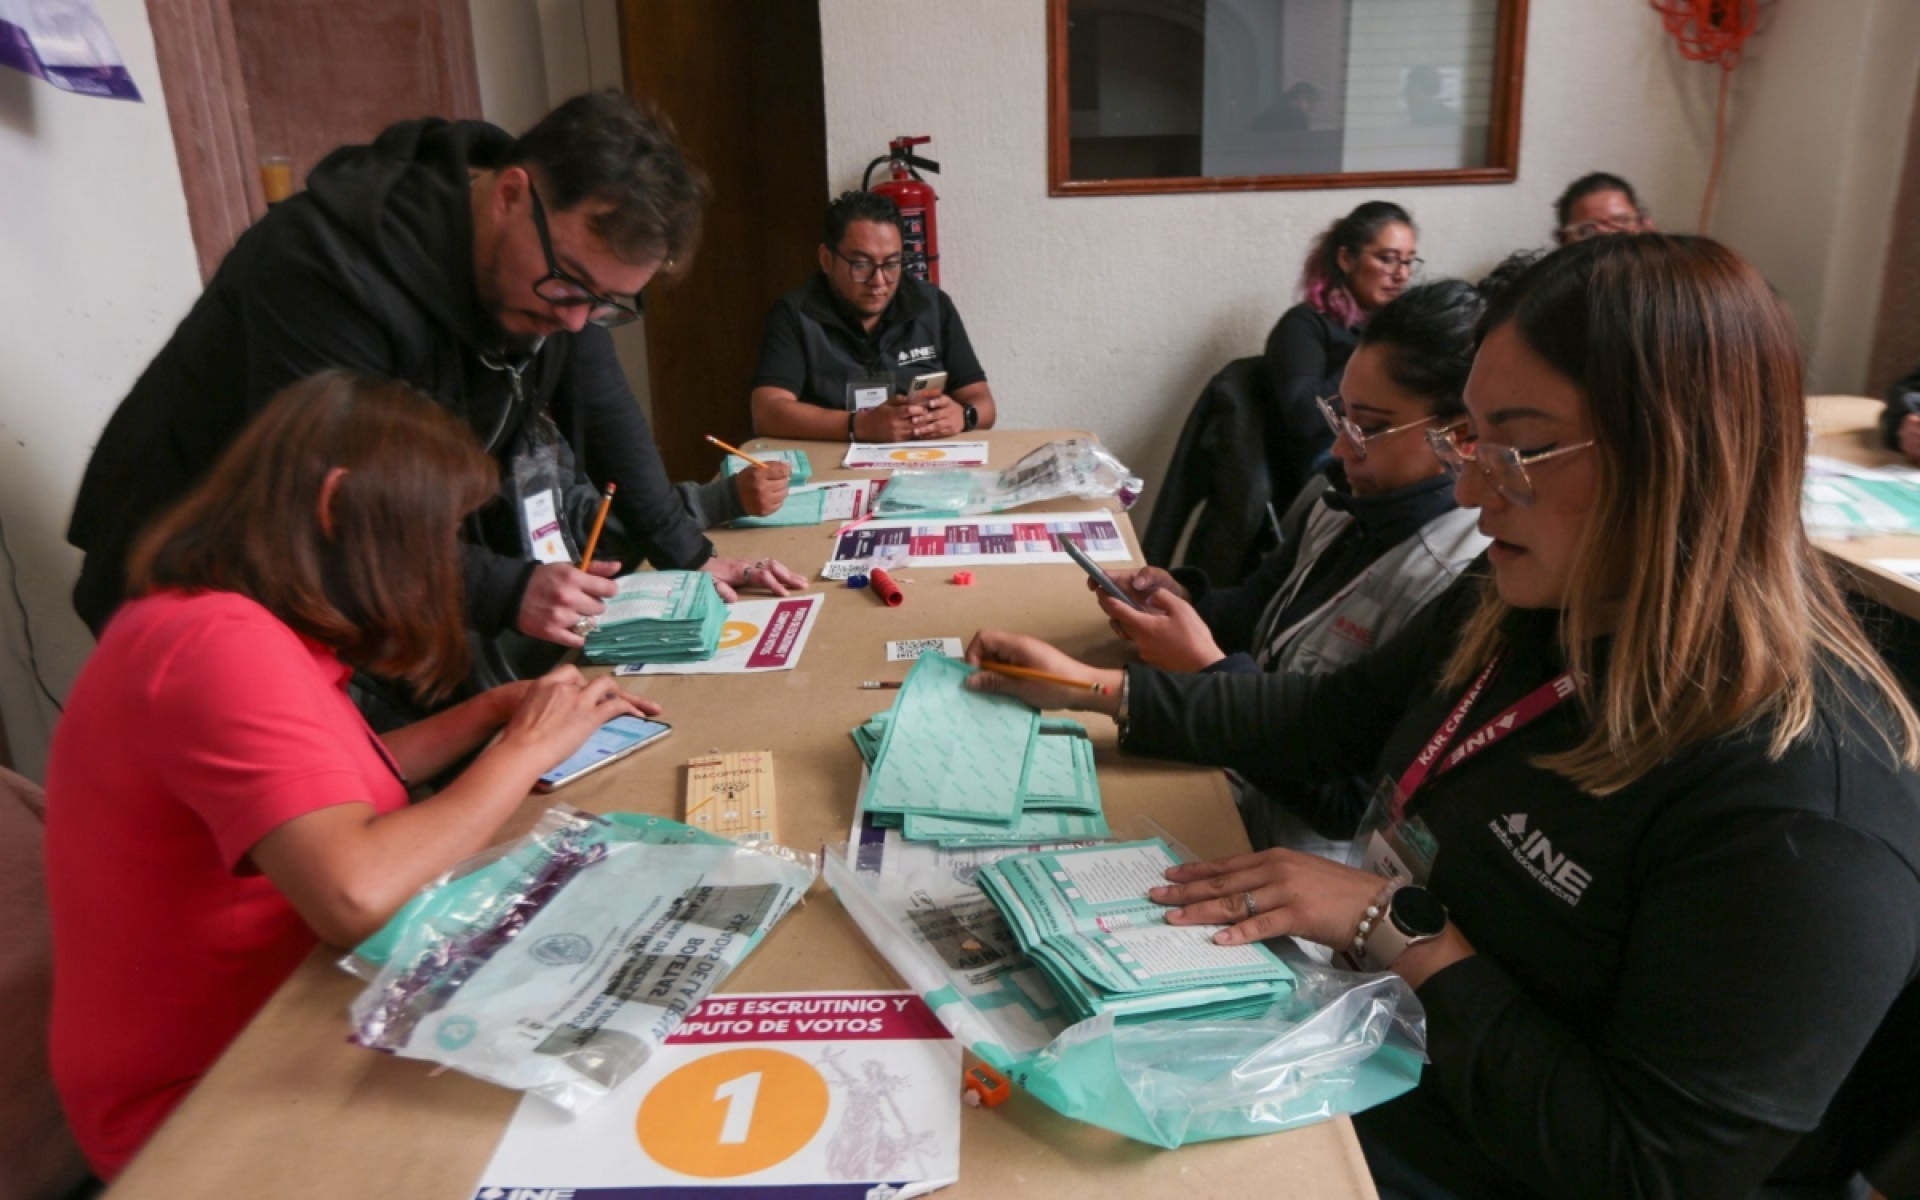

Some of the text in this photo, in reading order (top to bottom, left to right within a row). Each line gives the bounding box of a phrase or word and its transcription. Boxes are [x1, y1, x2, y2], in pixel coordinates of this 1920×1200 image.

[910, 346, 935, 358] INE
[1418, 733, 1448, 766] KAR
[1450, 726, 1496, 766] INE
[1520, 828, 1593, 898] INE
[705, 1001, 739, 1017] DE
[743, 998, 886, 1015] ESCRUTINIO
[895, 998, 910, 1012] Y
[670, 1017, 884, 1036] MPUTO DE VOTOS
[713, 1071, 764, 1146] 1
